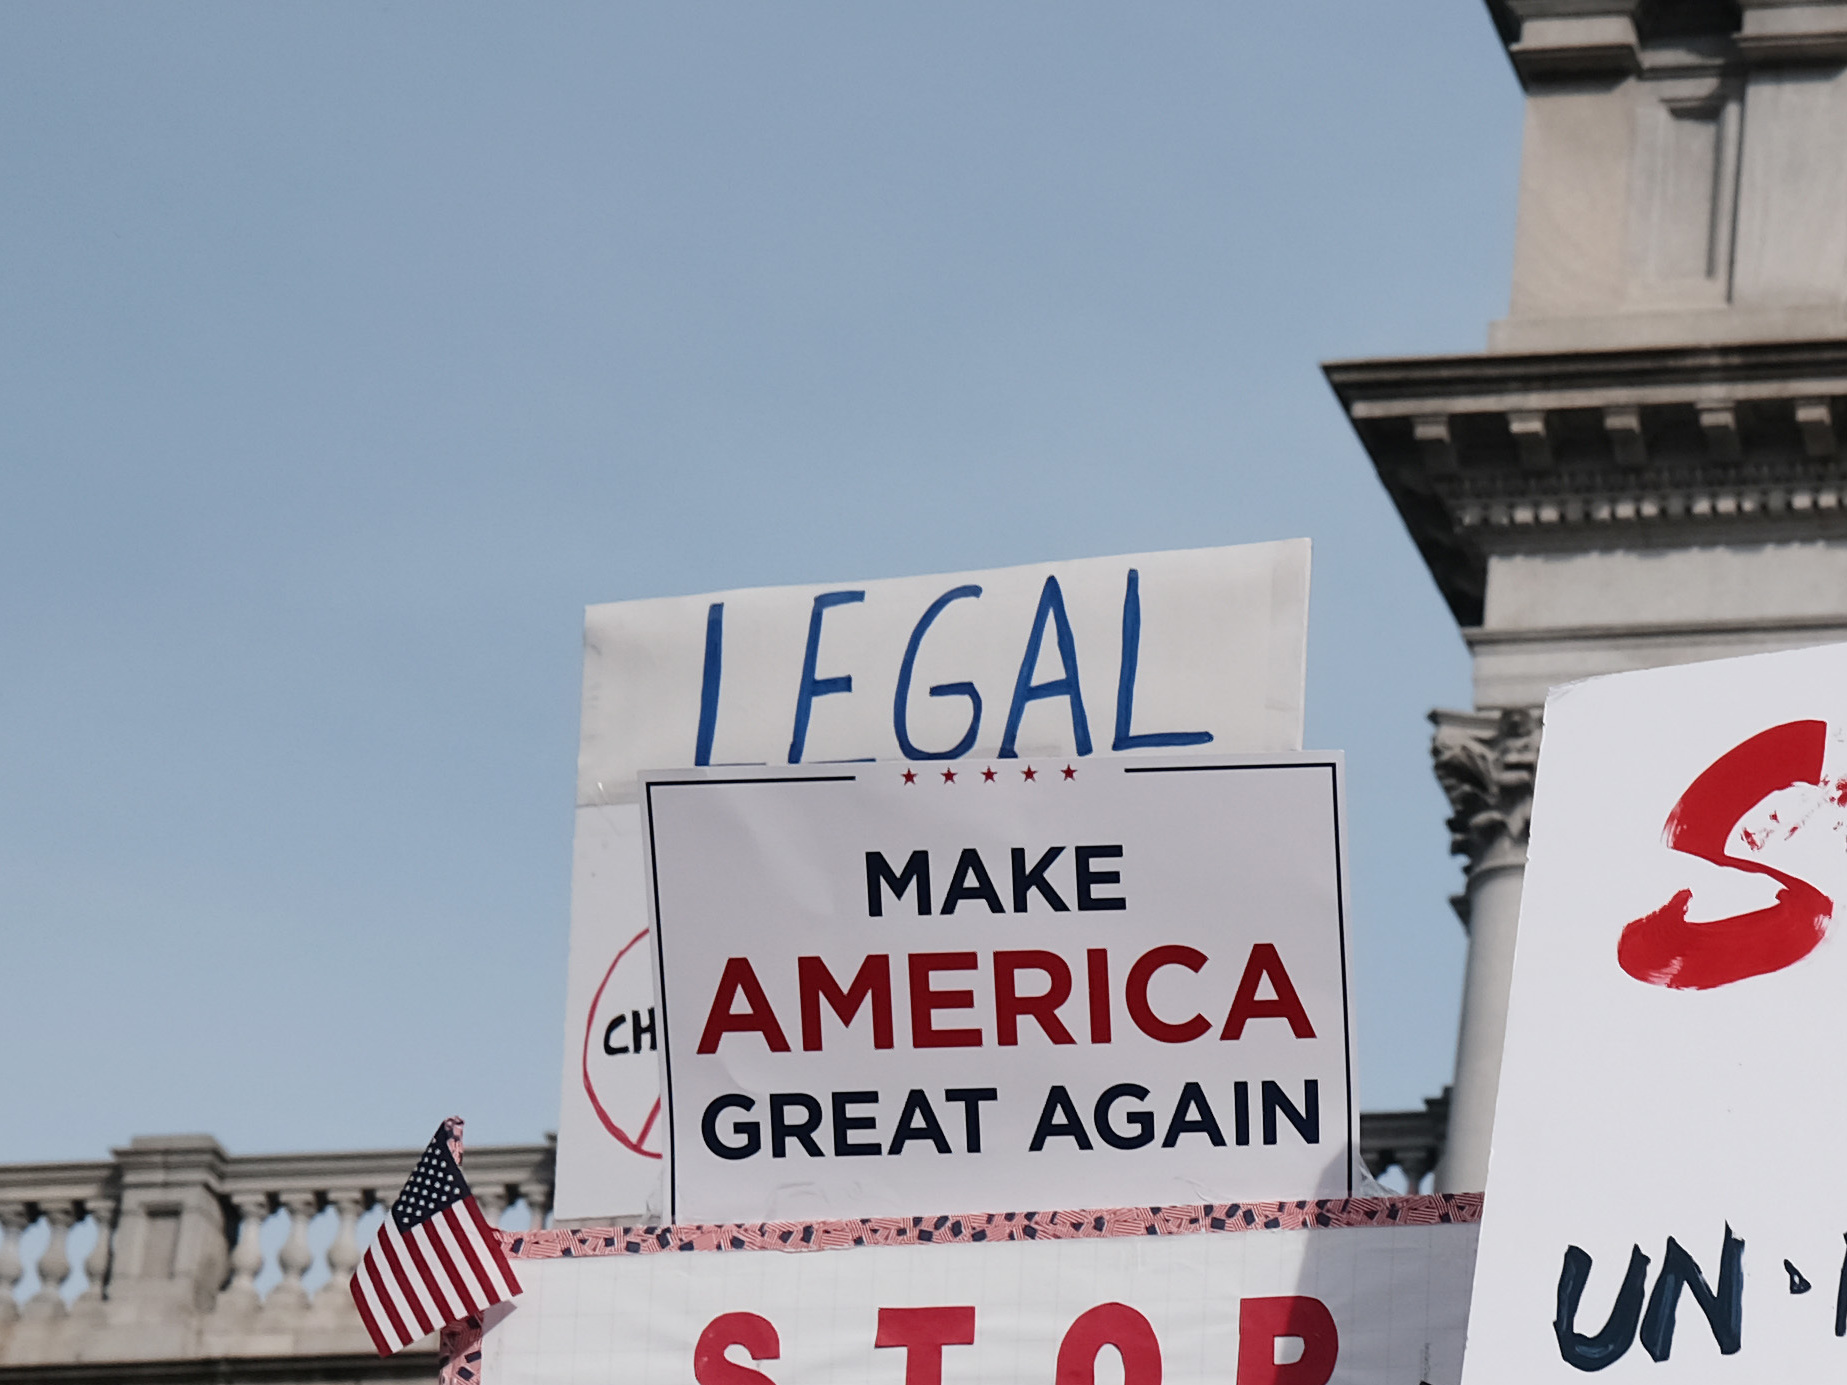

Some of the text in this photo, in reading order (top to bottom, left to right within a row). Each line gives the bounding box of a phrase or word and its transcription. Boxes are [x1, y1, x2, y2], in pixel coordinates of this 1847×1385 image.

[865, 844, 1127, 918] MAKE
[696, 943, 1316, 1055] AMERICA
[701, 1079, 1320, 1161] GREAT AGAIN
